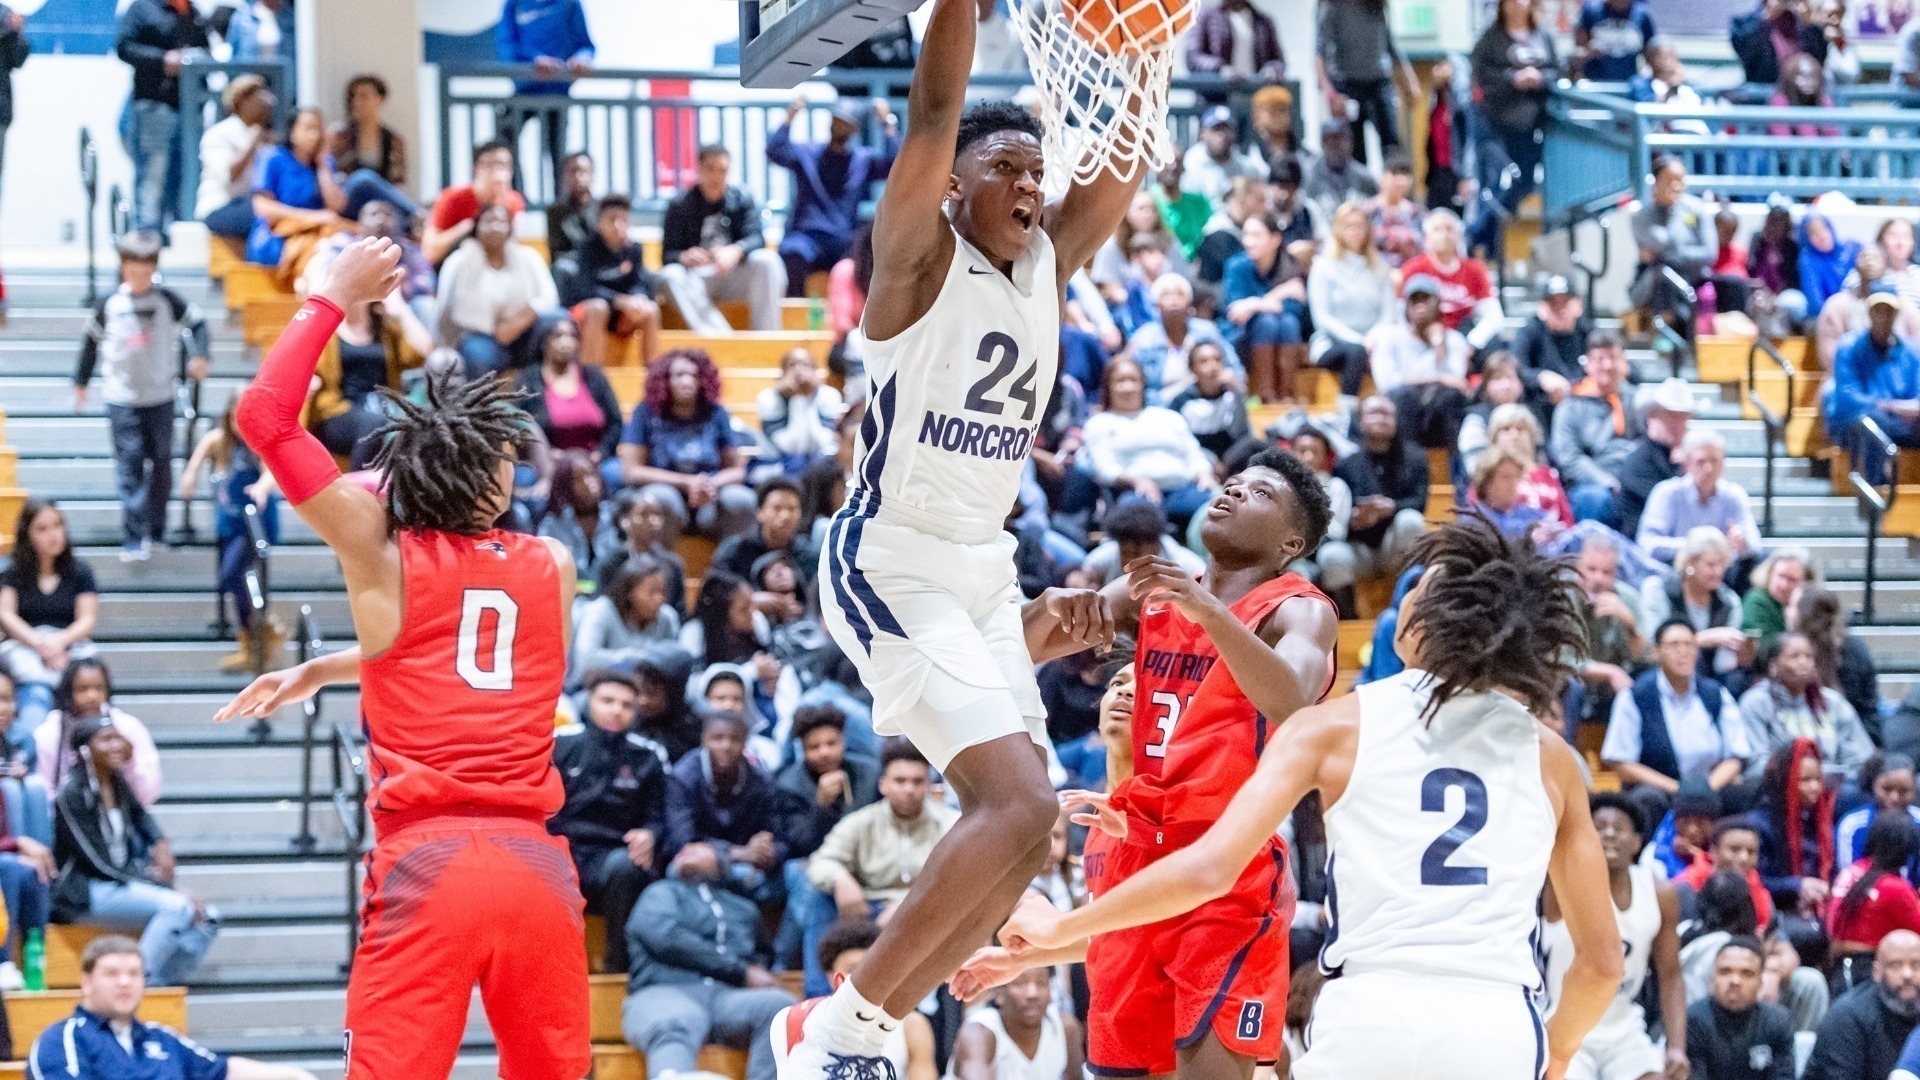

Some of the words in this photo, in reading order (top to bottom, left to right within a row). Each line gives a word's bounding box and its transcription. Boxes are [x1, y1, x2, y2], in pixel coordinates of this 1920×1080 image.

[964, 331, 1038, 421] 24
[918, 410, 1038, 461] NORCRO
[455, 588, 520, 691] 0
[1144, 690, 1194, 759] 3
[1420, 767, 1488, 886] 2
[1236, 999, 1265, 1041] B
